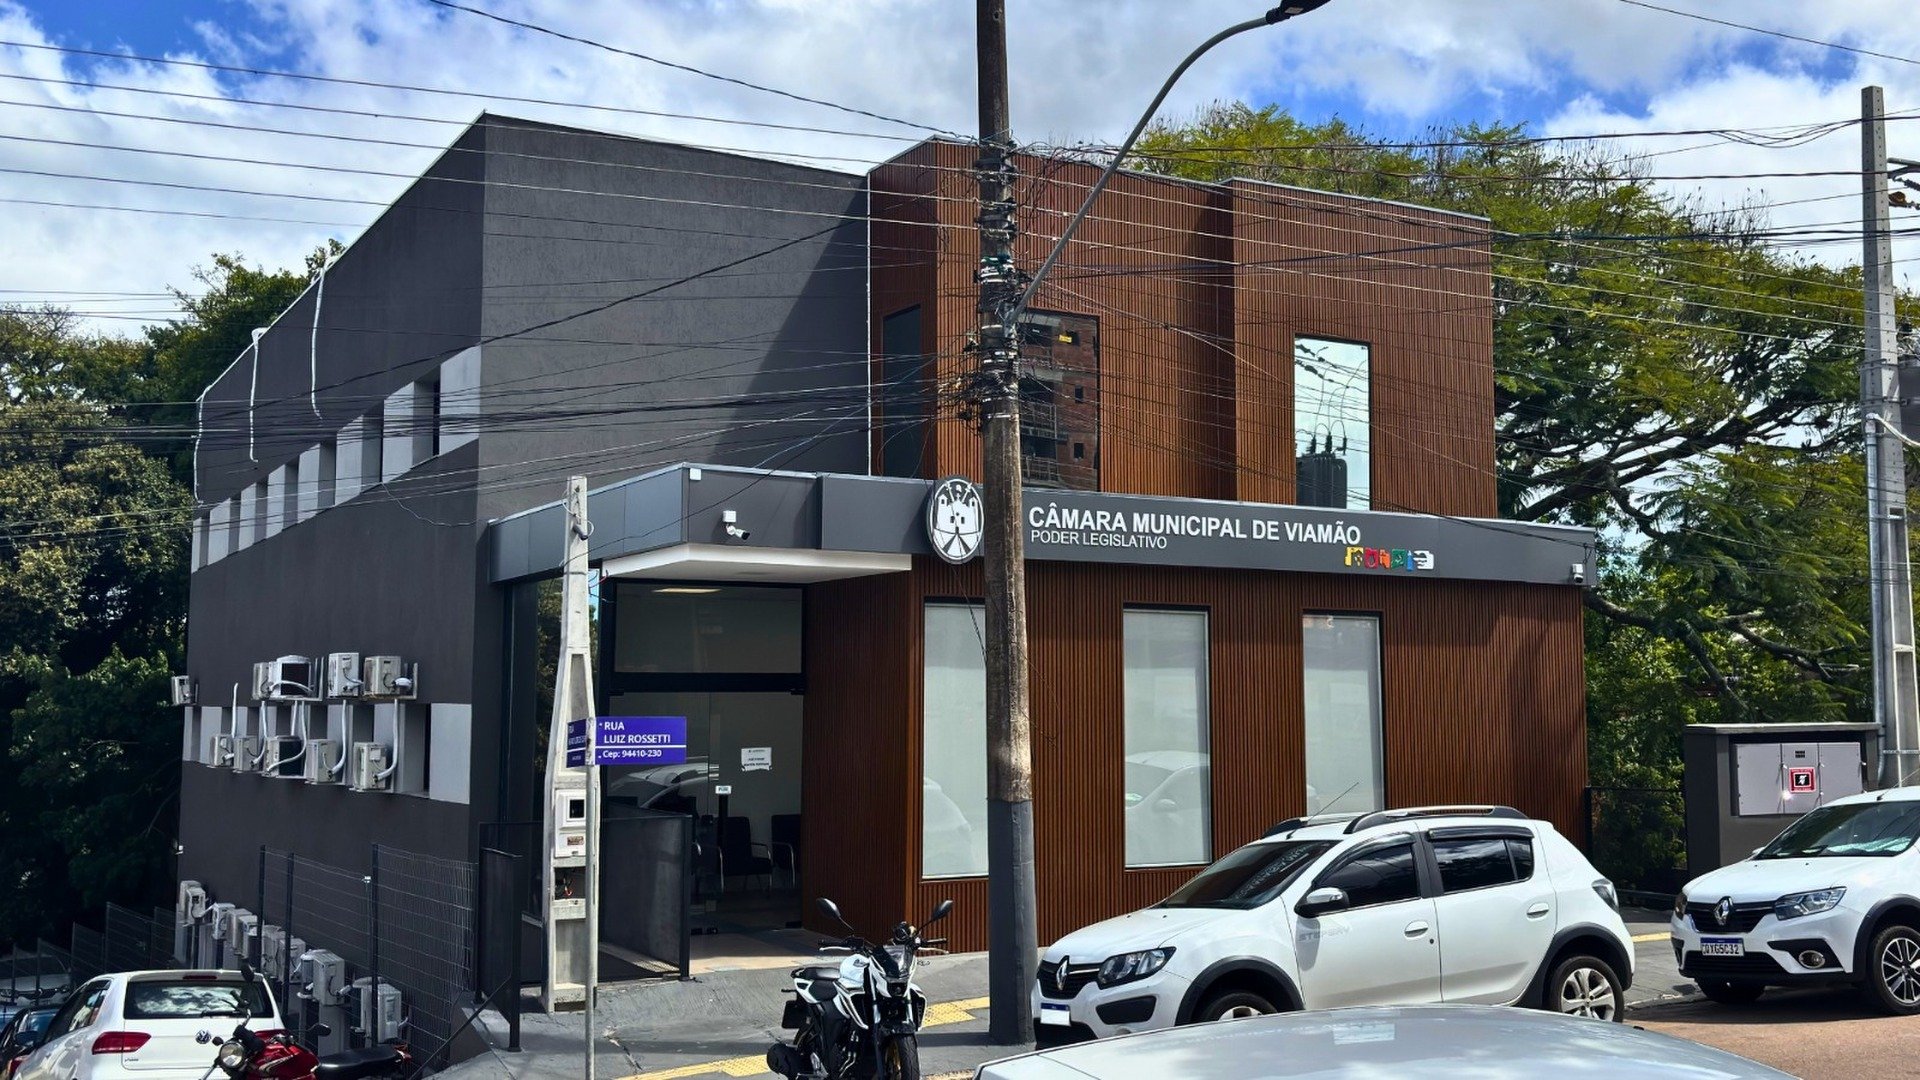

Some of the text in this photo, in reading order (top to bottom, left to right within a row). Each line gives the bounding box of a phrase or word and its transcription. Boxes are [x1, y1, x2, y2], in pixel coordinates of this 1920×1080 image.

[1029, 502, 1361, 545] CÂMARA MUNICIPAL DE VIAMÃO
[1031, 530, 1167, 549] PODER LEGISLATIVO
[604, 721, 625, 731] RUA
[604, 734, 671, 744] LUIZ ROSSETTI
[602, 749, 662, 759] Cep: 94410-230
